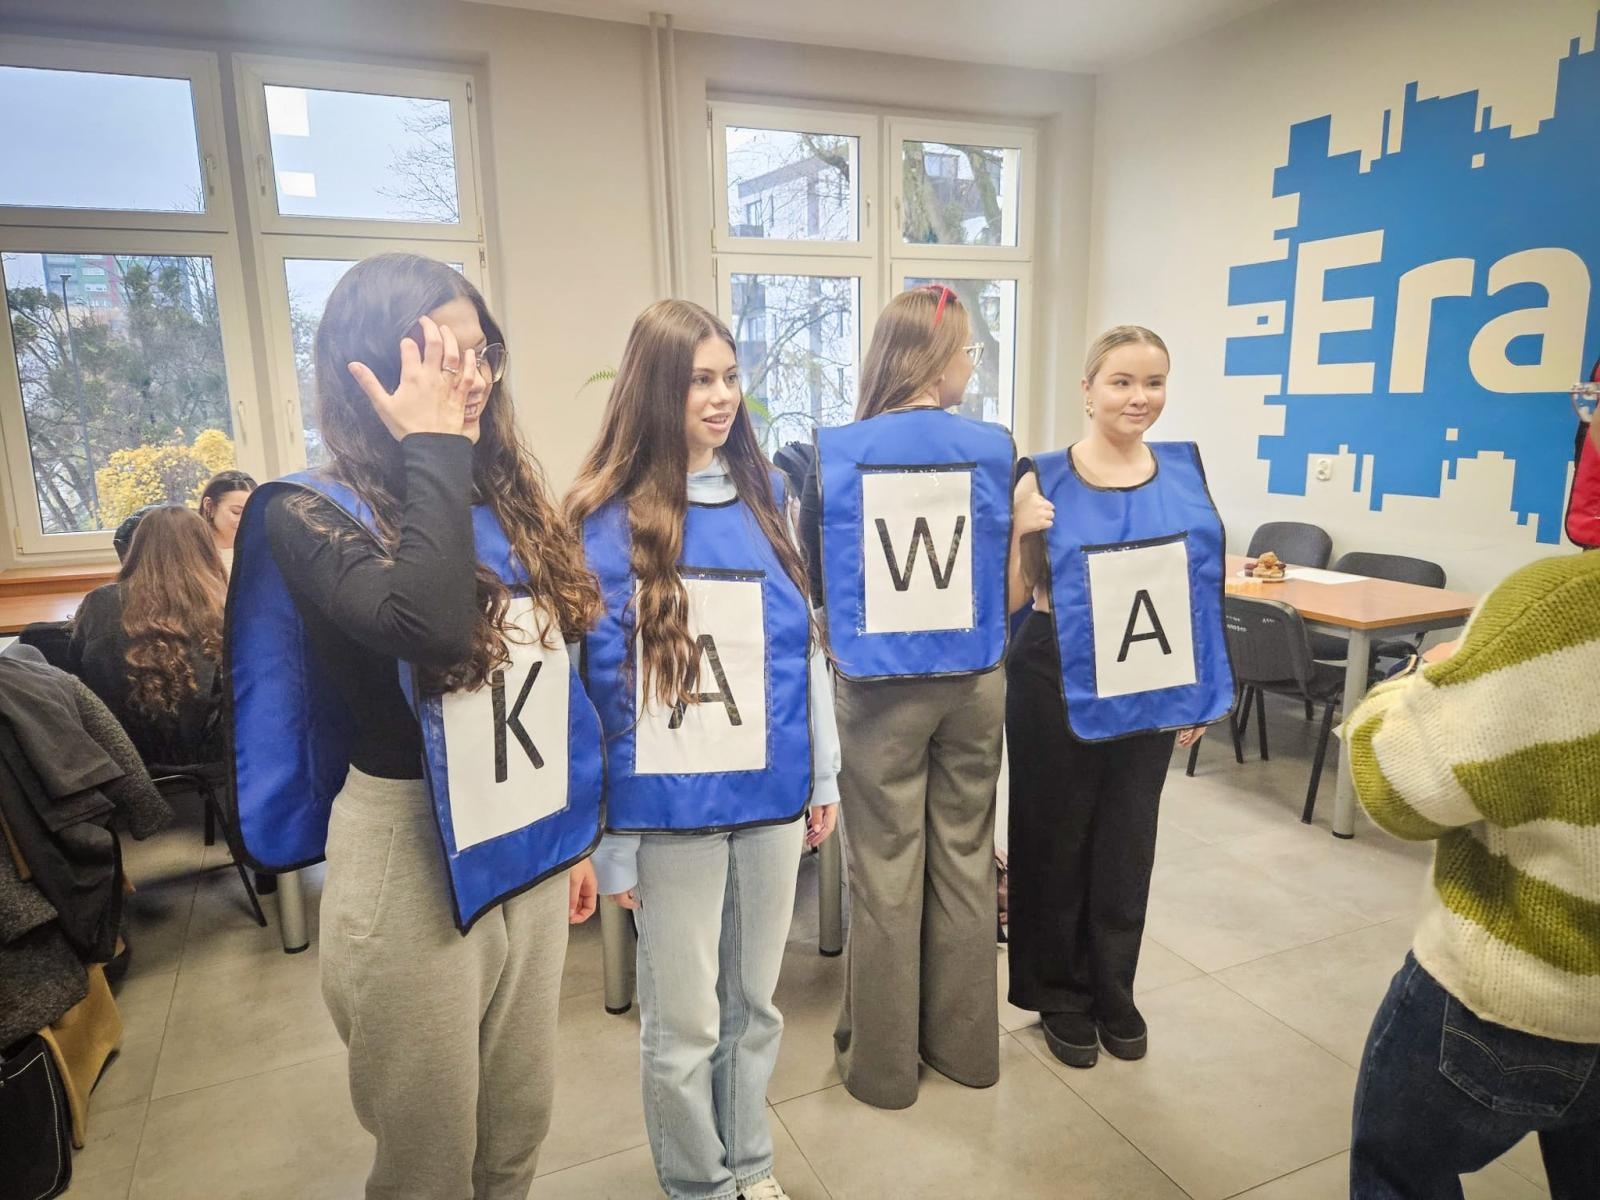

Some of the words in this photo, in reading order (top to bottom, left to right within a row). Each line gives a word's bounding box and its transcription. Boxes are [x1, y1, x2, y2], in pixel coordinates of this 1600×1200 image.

[1287, 229, 1591, 395] Era
[874, 515, 966, 592] W
[1116, 589, 1172, 663] A
[491, 660, 545, 783] K
[668, 634, 743, 729] A
